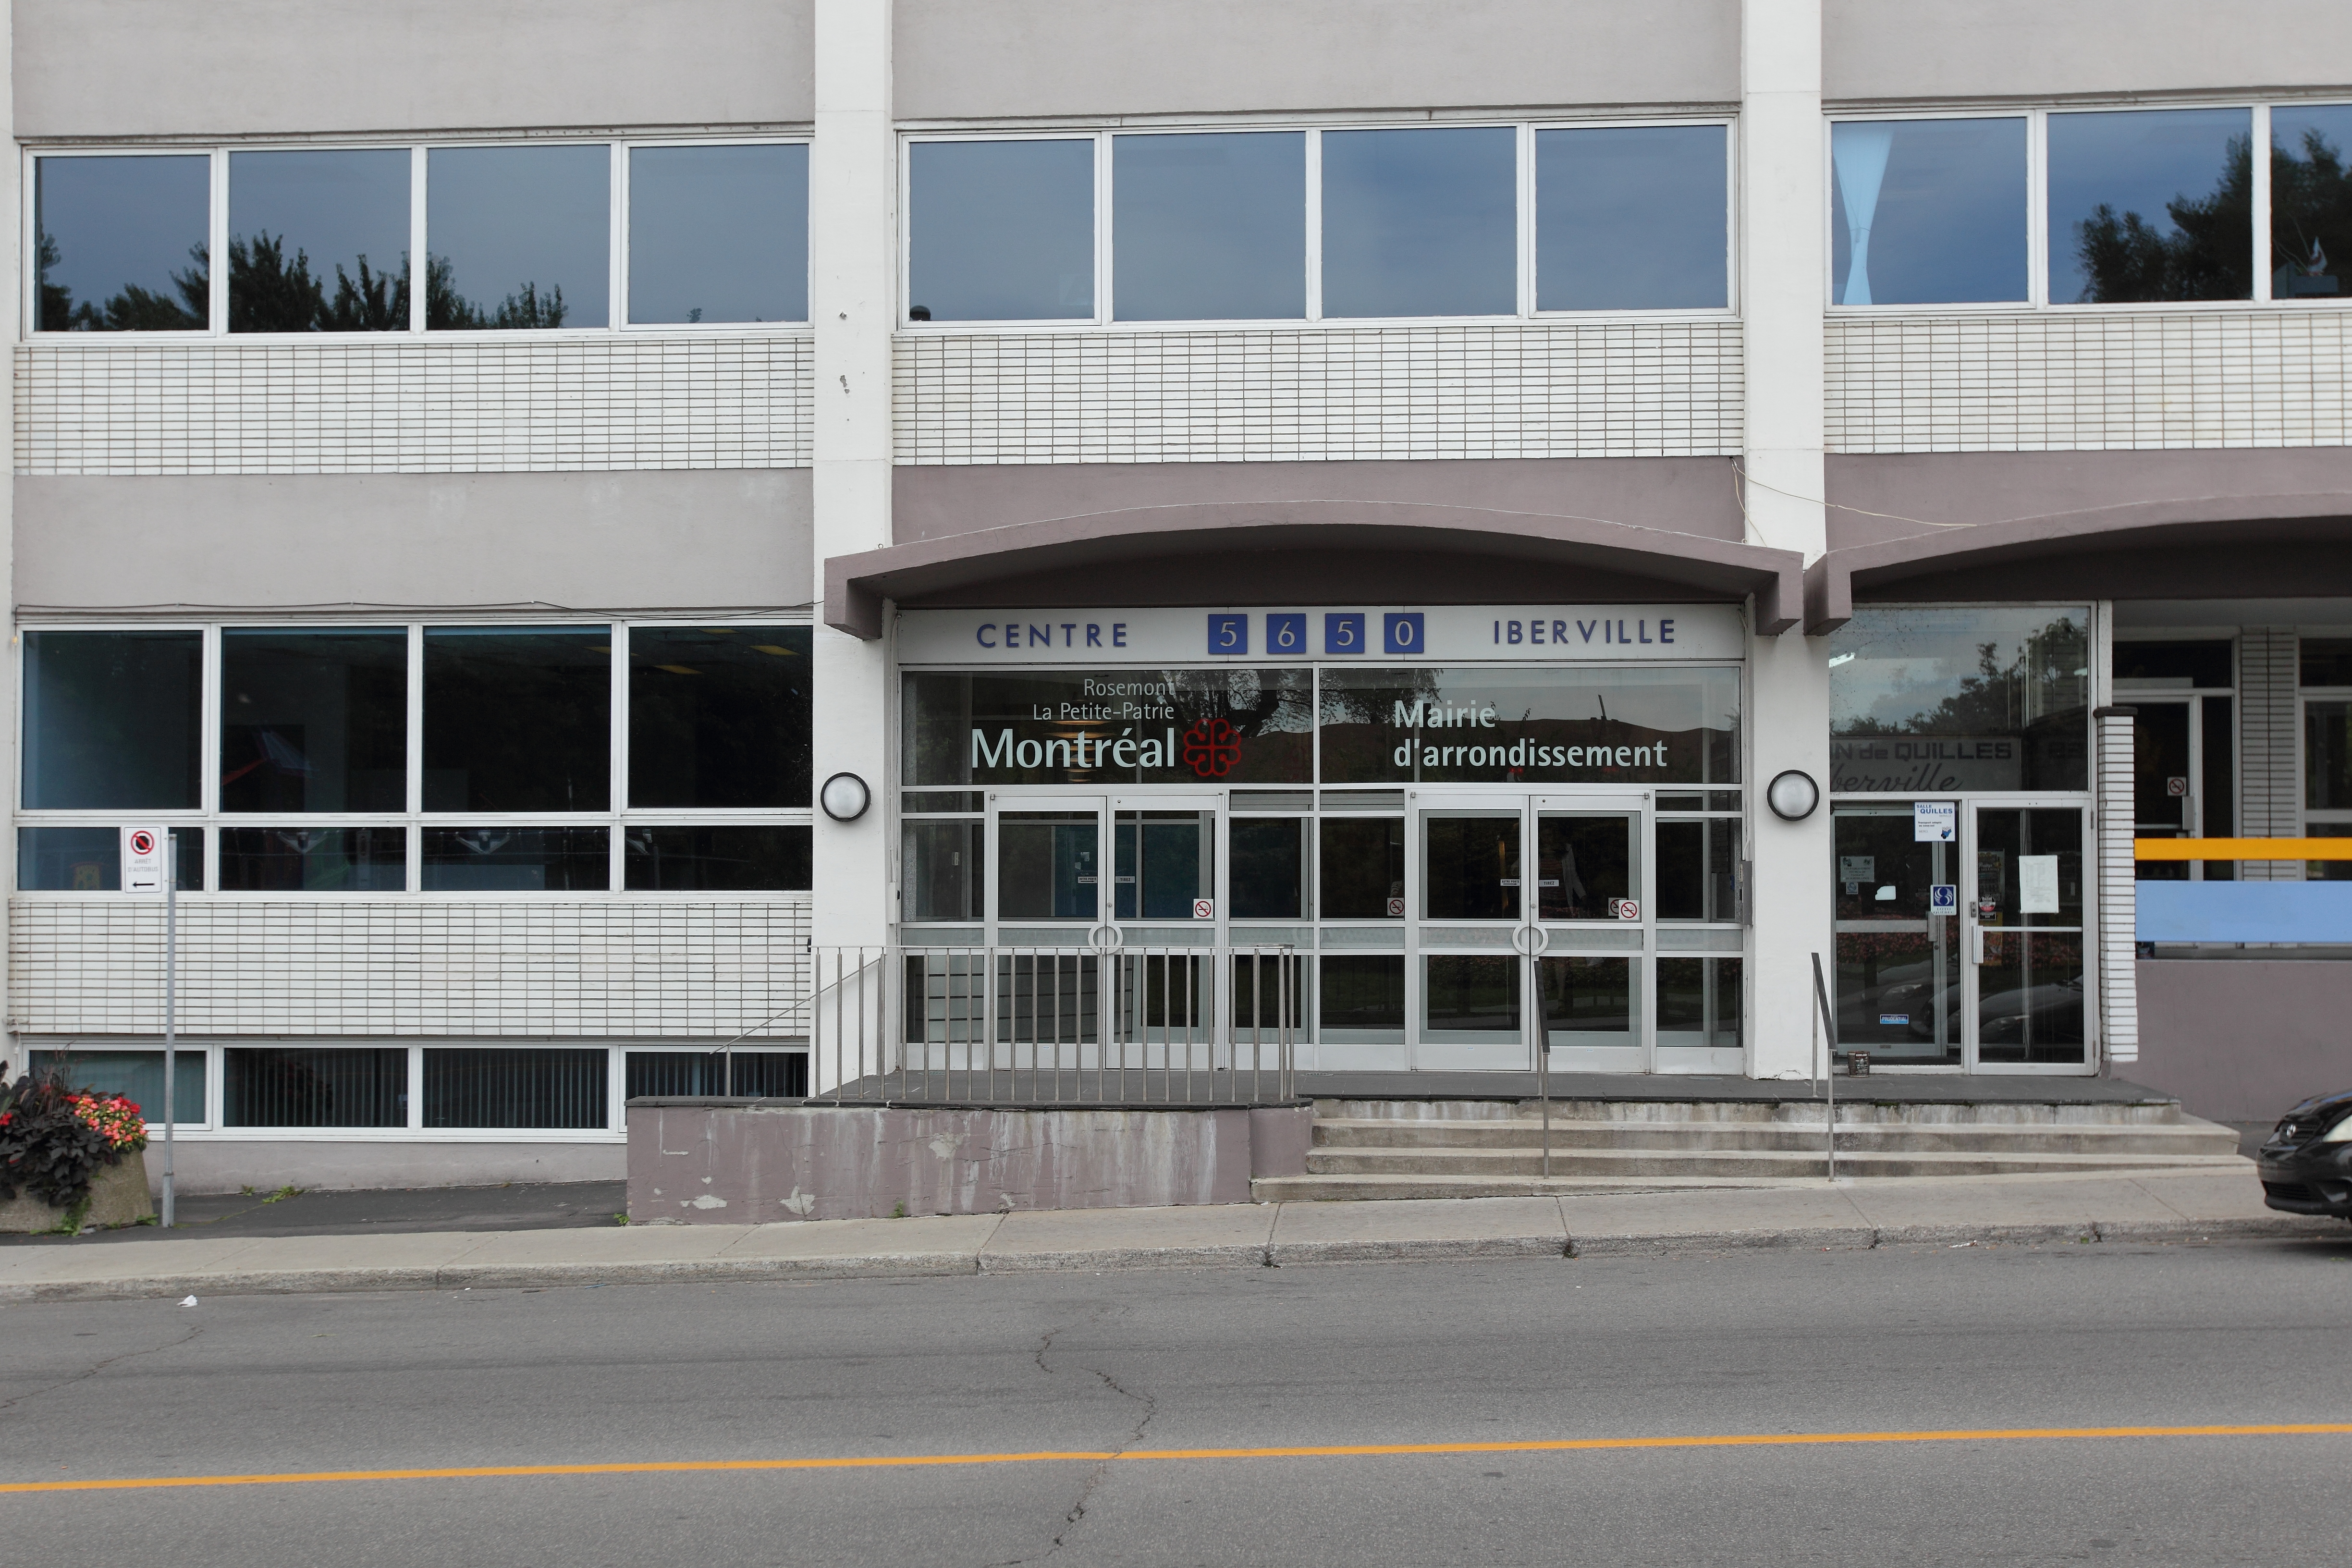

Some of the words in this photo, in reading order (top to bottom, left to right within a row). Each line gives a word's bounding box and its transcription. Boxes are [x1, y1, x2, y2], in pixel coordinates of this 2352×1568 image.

[976, 623, 1127, 649] CENTRE
[1494, 619, 1675, 644] IBERVILLE
[1084, 678, 1175, 697] Rosemont
[1033, 704, 1052, 721] La
[1061, 702, 1175, 721] Petite-Patrie
[1395, 699, 1496, 728] Mairie
[972, 727, 1175, 769] Montréal
[1394, 738, 1668, 768] d'arrondissement
[1859, 743, 1888, 760] de
[1895, 742, 2011, 762] QUILLES
